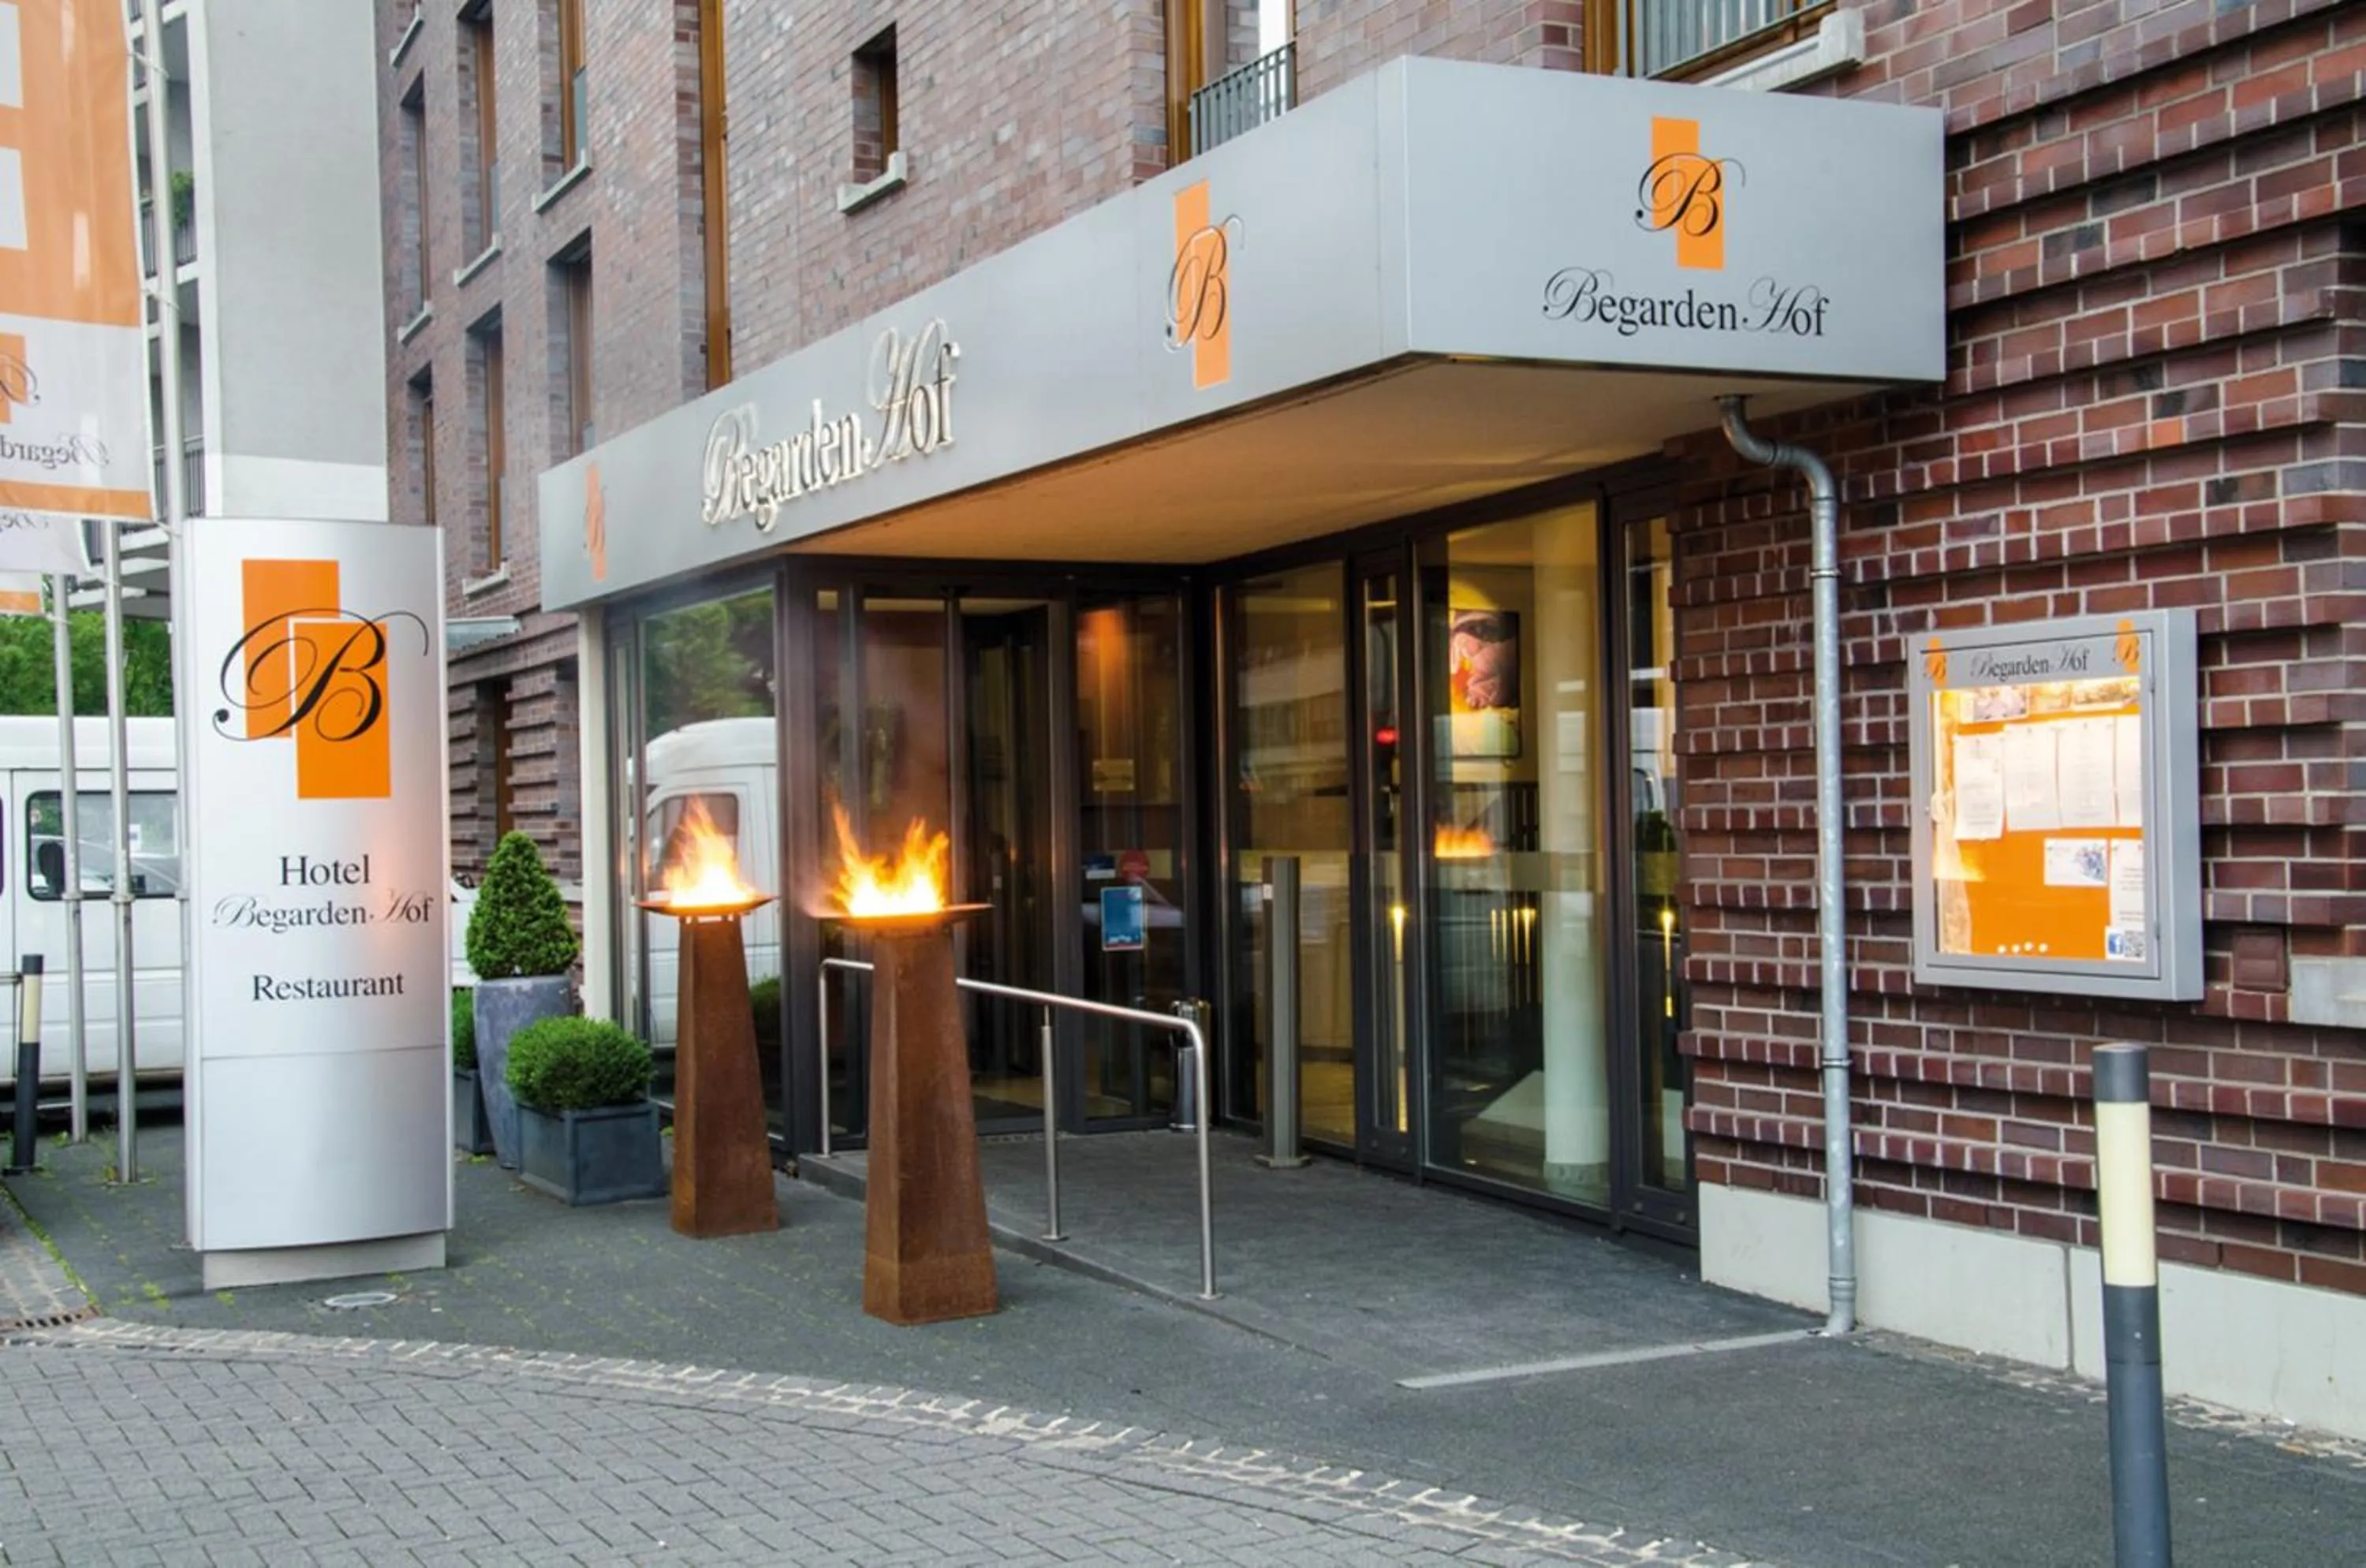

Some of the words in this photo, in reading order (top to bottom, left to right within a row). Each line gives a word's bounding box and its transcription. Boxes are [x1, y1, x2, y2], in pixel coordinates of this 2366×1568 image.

[1634, 151, 1746, 237] B
[1163, 213, 1245, 353] B
[1542, 266, 1738, 337] Begarden
[1741, 275, 1830, 337] Hof
[702, 398, 866, 533] Begarden
[864, 316, 961, 469] Hof
[212, 607, 429, 743] B
[1970, 651, 2050, 683] Begarden
[2052, 643, 2089, 672] Hof
[280, 853, 371, 886] Hotel
[213, 894, 368, 934] Begarden
[368, 886, 434, 925] Hof
[252, 971, 405, 1002] Restaurant
